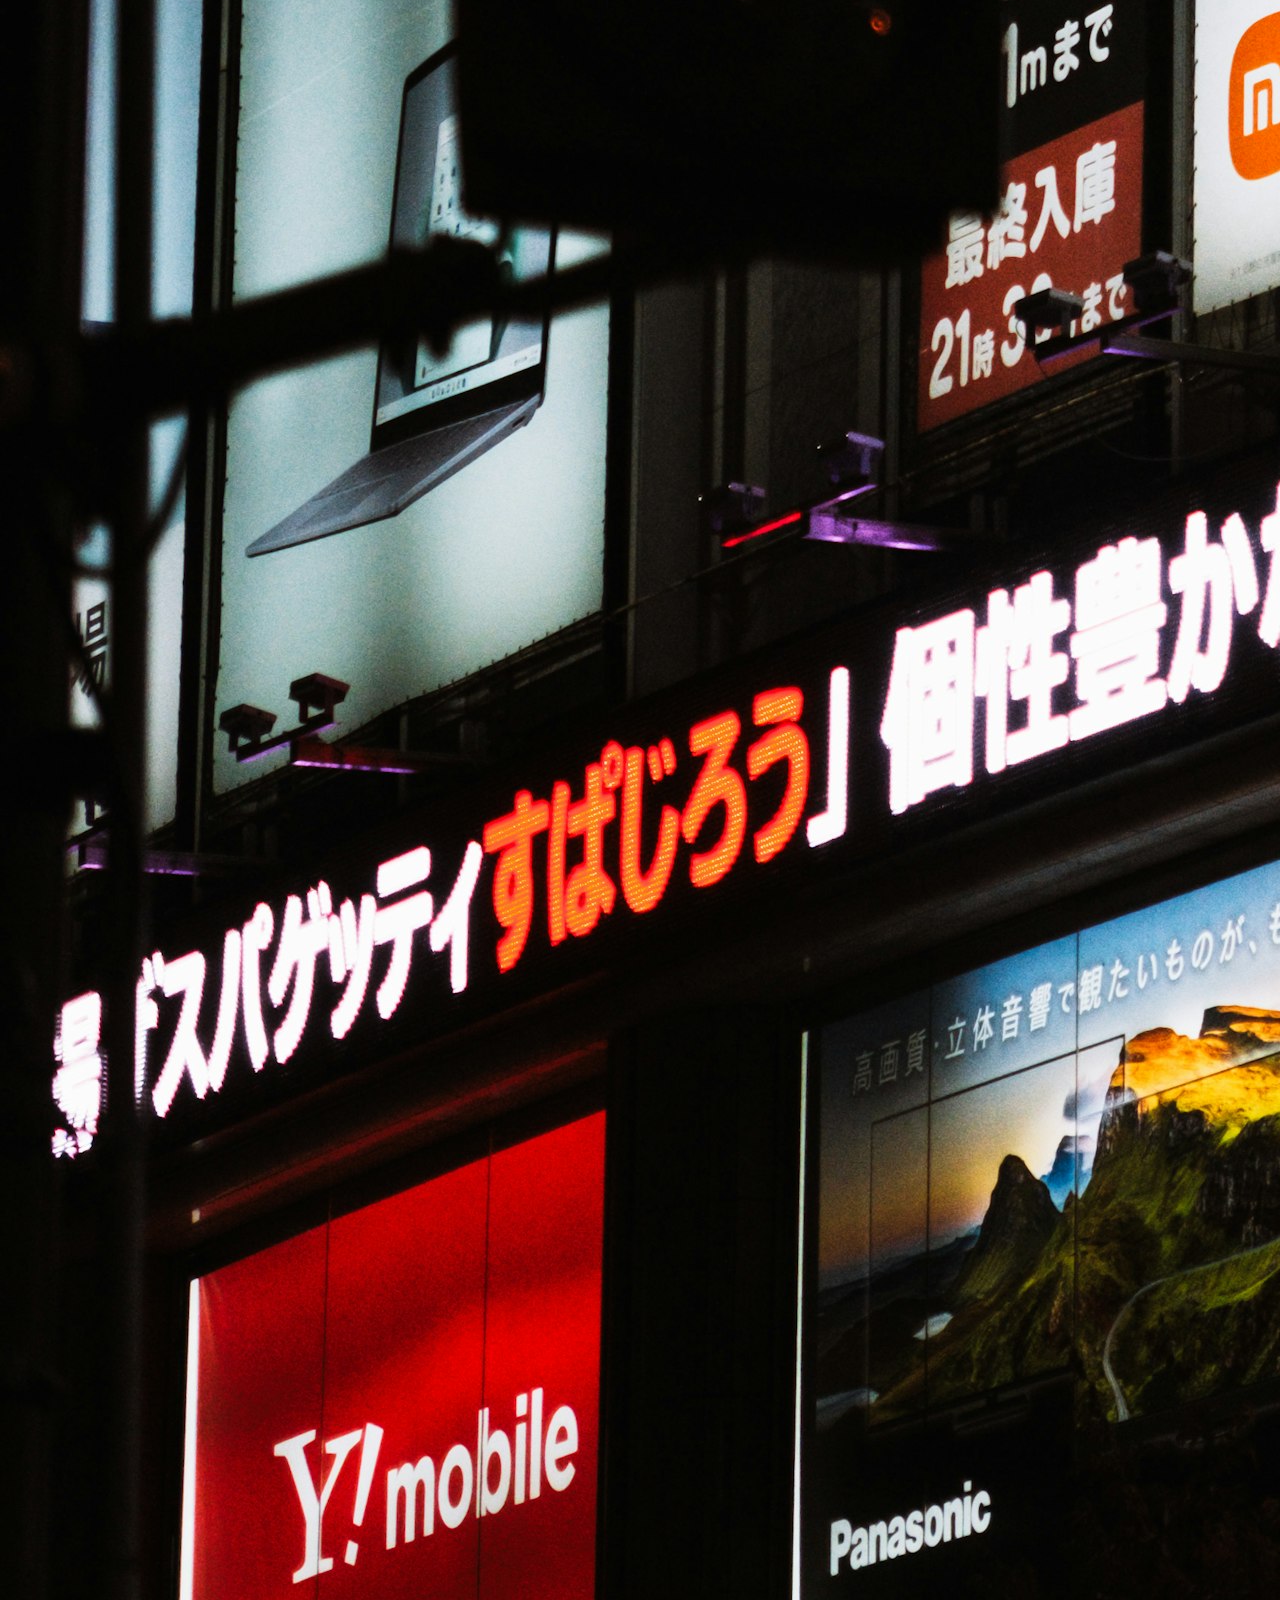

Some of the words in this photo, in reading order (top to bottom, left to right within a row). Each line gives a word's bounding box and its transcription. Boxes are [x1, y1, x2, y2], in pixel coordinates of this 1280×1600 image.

[944, 140, 1118, 289] 最終入庫
[829, 1479, 992, 1577] Panasonic
